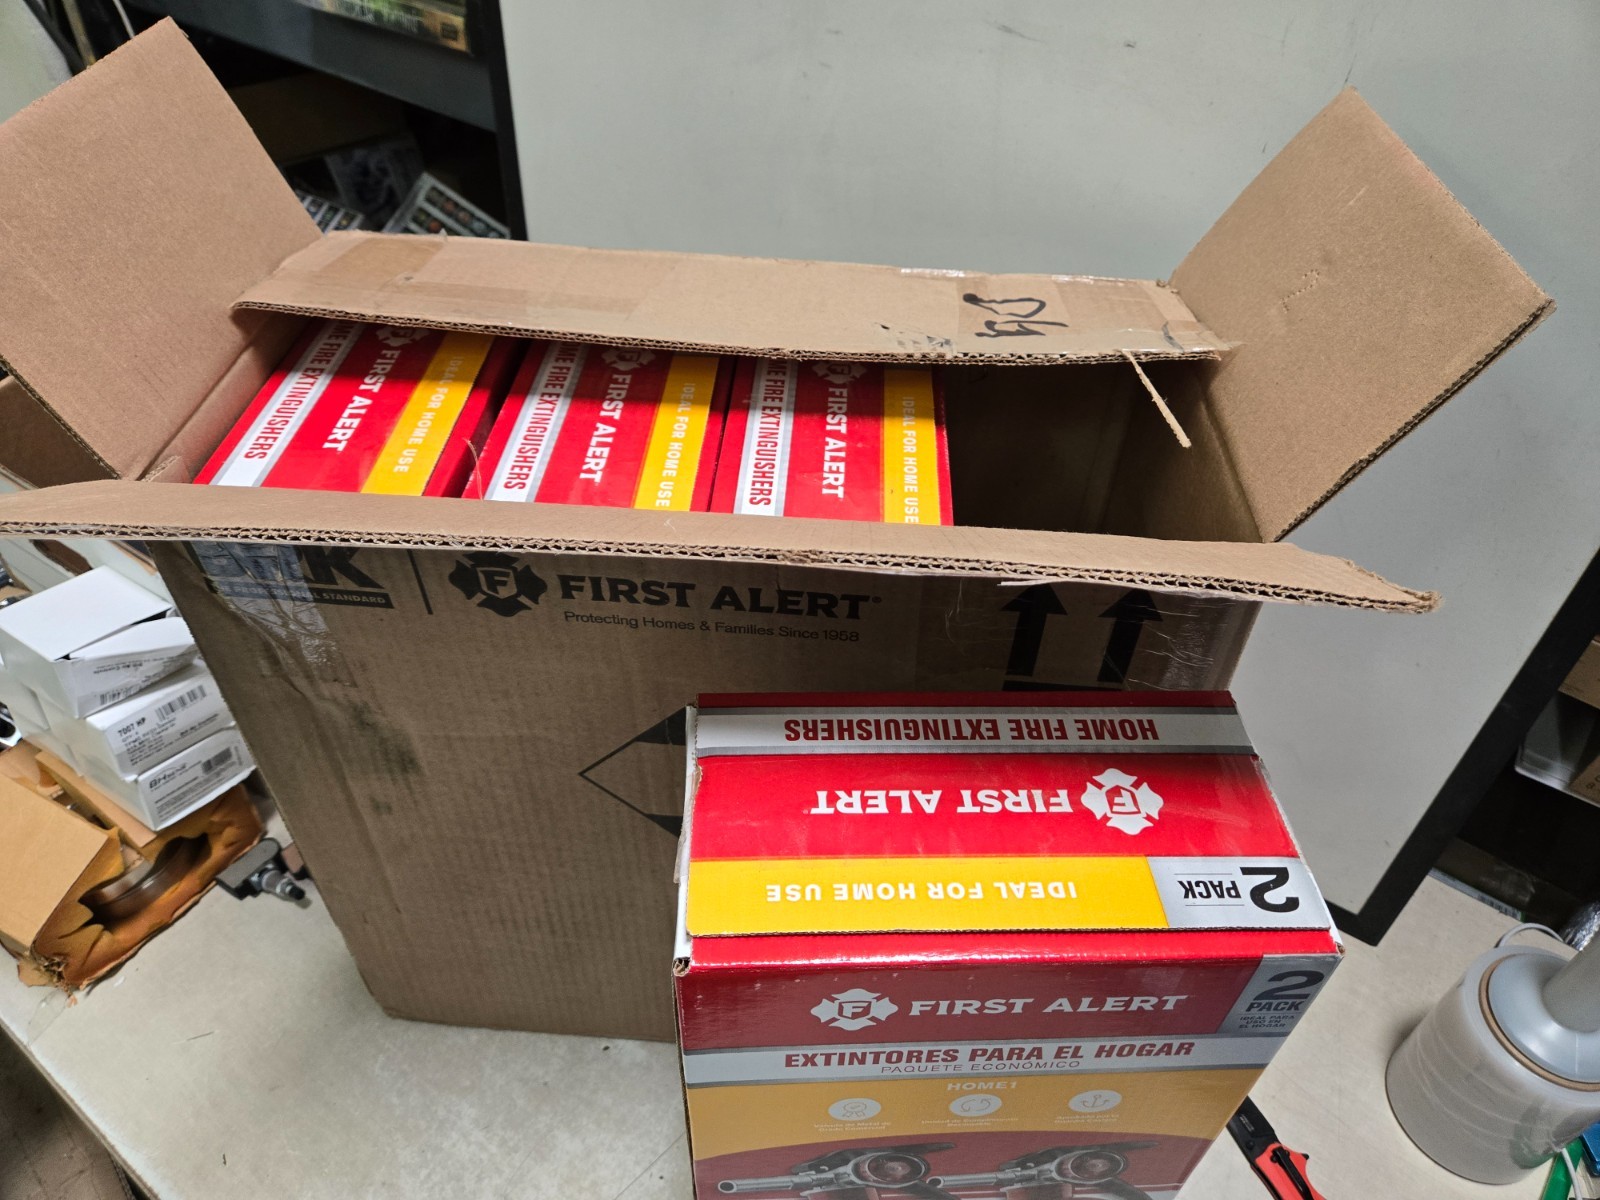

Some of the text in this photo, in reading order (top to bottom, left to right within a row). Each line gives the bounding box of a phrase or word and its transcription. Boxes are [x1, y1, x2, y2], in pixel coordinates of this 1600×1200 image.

[310, 342, 342, 365] FIRE
[545, 366, 571, 389] FIRE
[762, 379, 786, 403] FIRE
[244, 367, 326, 459] EXTINGUISHERS
[322, 349, 401, 452] FIRST ALERT
[393, 356, 464, 473] IDEAL FOR HOME USE
[504, 391, 562, 490] EXTINGUISHERS
[579, 374, 632, 483] FIRST ALERT
[655, 382, 696, 508] IDEAL FOR HOME USE
[749, 405, 783, 506] EXTINGUISHERS
[822, 388, 848, 499] FIRST ALERT
[902, 396, 919, 524] IDEAL FOR HOME USE
[322, 592, 387, 605] STANDARD
[556, 574, 872, 620] FIRST ALERT
[564, 611, 861, 643] Protecting Homes & Families Since 1958
[784, 718, 1161, 742] HOME FIRE EXTINGUISHERS
[810, 789, 1074, 815] FIRST ALERT
[766, 881, 1078, 902] IDEAL FOR HOME USE
[1176, 880, 1243, 899] PACK
[1239, 866, 1300, 912] 2
[1253, 970, 1325, 1001] 2
[909, 995, 1190, 1016] FIRST ALERT
[1245, 1001, 1305, 1013] PACK
[785, 1041, 1196, 1068] EXTINTORES PARA EL HOGAR
[880, 1060, 1081, 1074] PAQUETE ECONÓMICO
[946, 1081, 1018, 1091] HOME1
